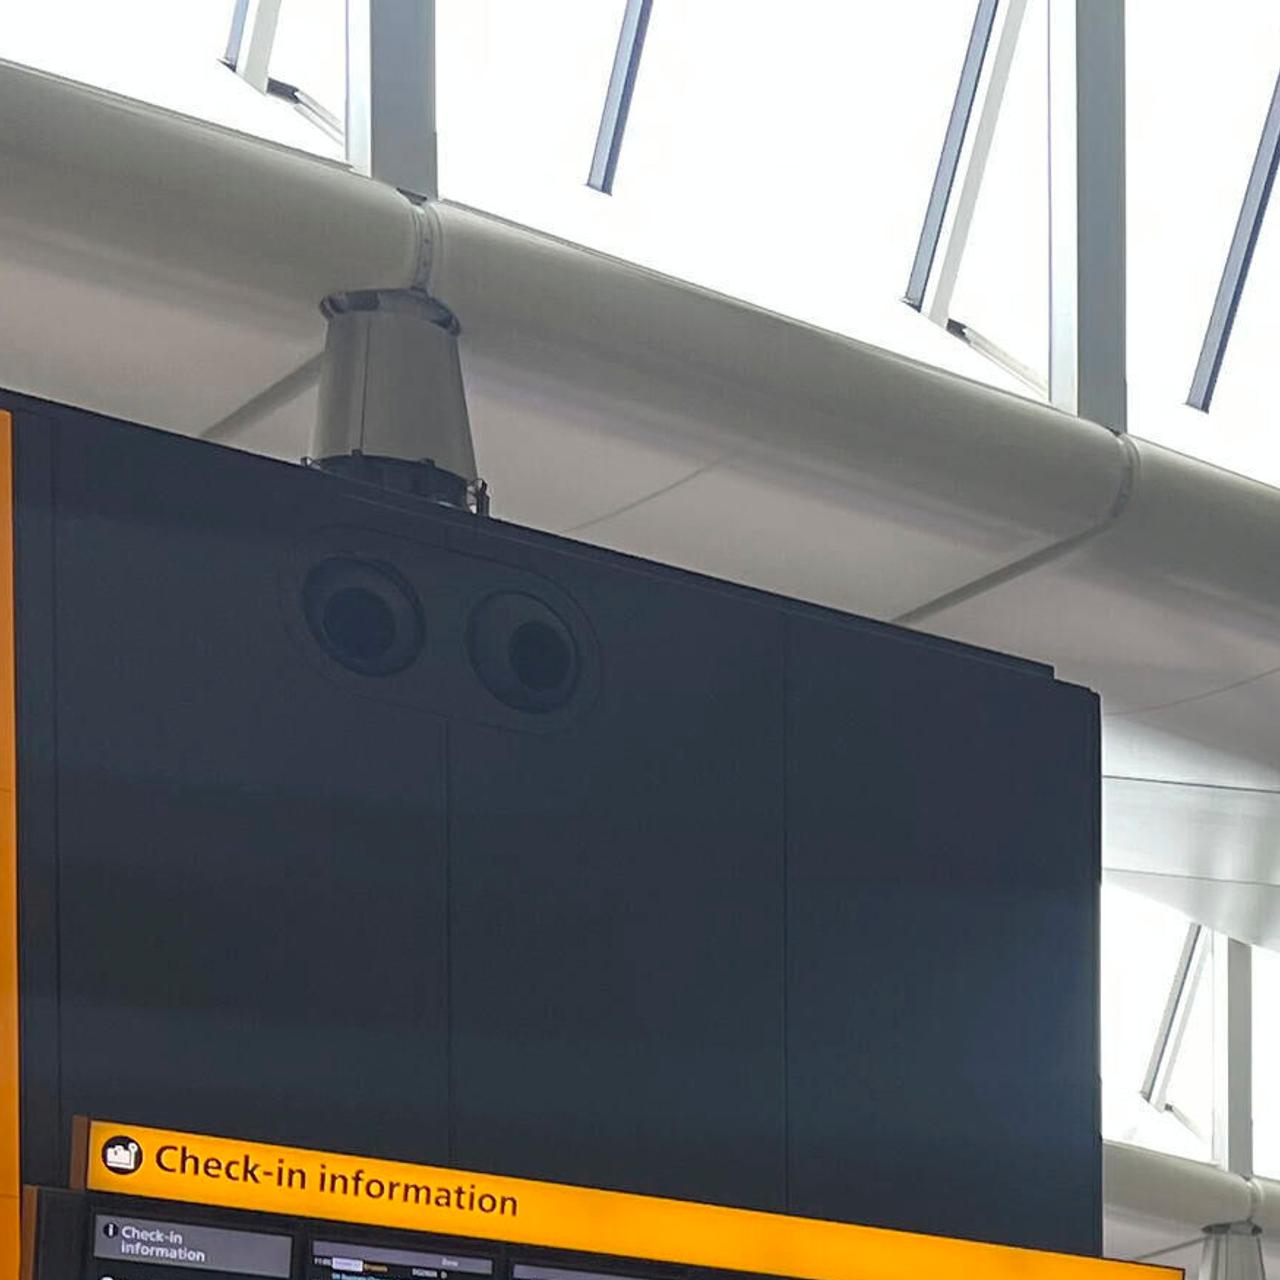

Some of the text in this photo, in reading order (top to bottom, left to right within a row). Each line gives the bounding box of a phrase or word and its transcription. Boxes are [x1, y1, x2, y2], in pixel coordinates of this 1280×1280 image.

[156, 1144, 518, 1217] Check-in information
[122, 1225, 183, 1244] Check-in
[121, 1241, 205, 1262] information
